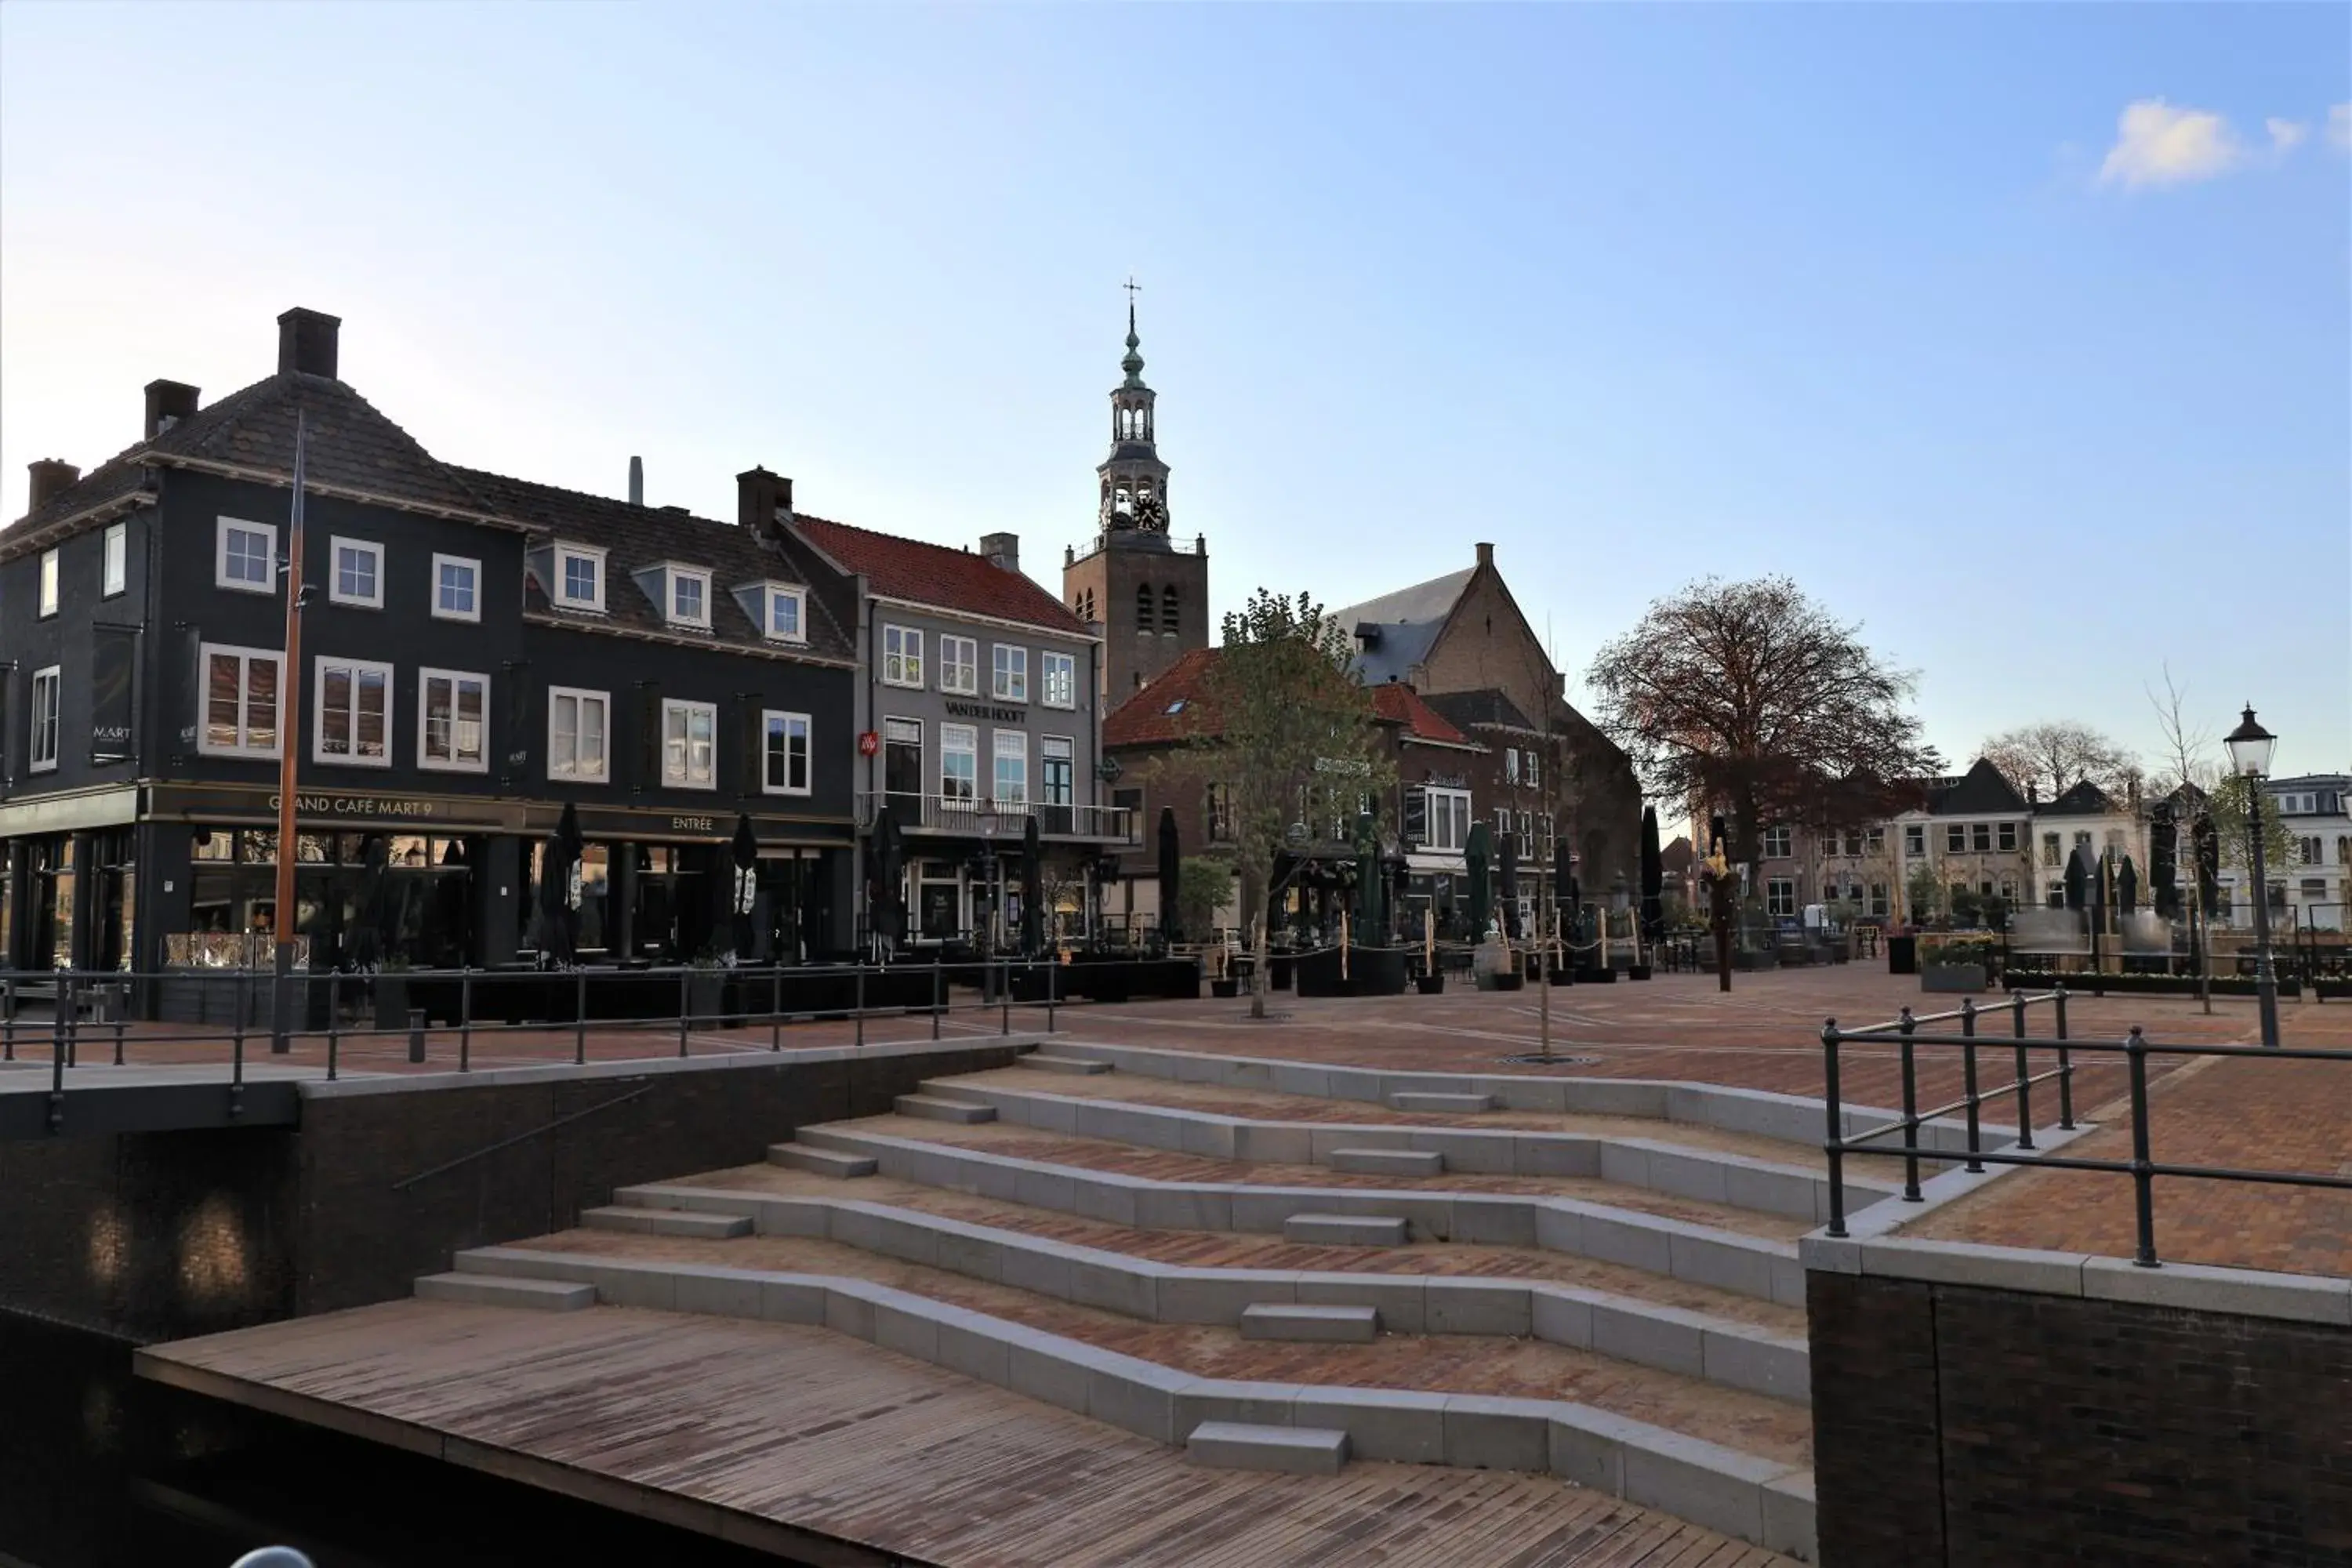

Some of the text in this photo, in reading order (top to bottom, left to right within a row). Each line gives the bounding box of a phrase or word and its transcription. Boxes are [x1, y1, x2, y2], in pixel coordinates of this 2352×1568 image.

[269, 796, 432, 816] GAND CAFÉ MART 9
